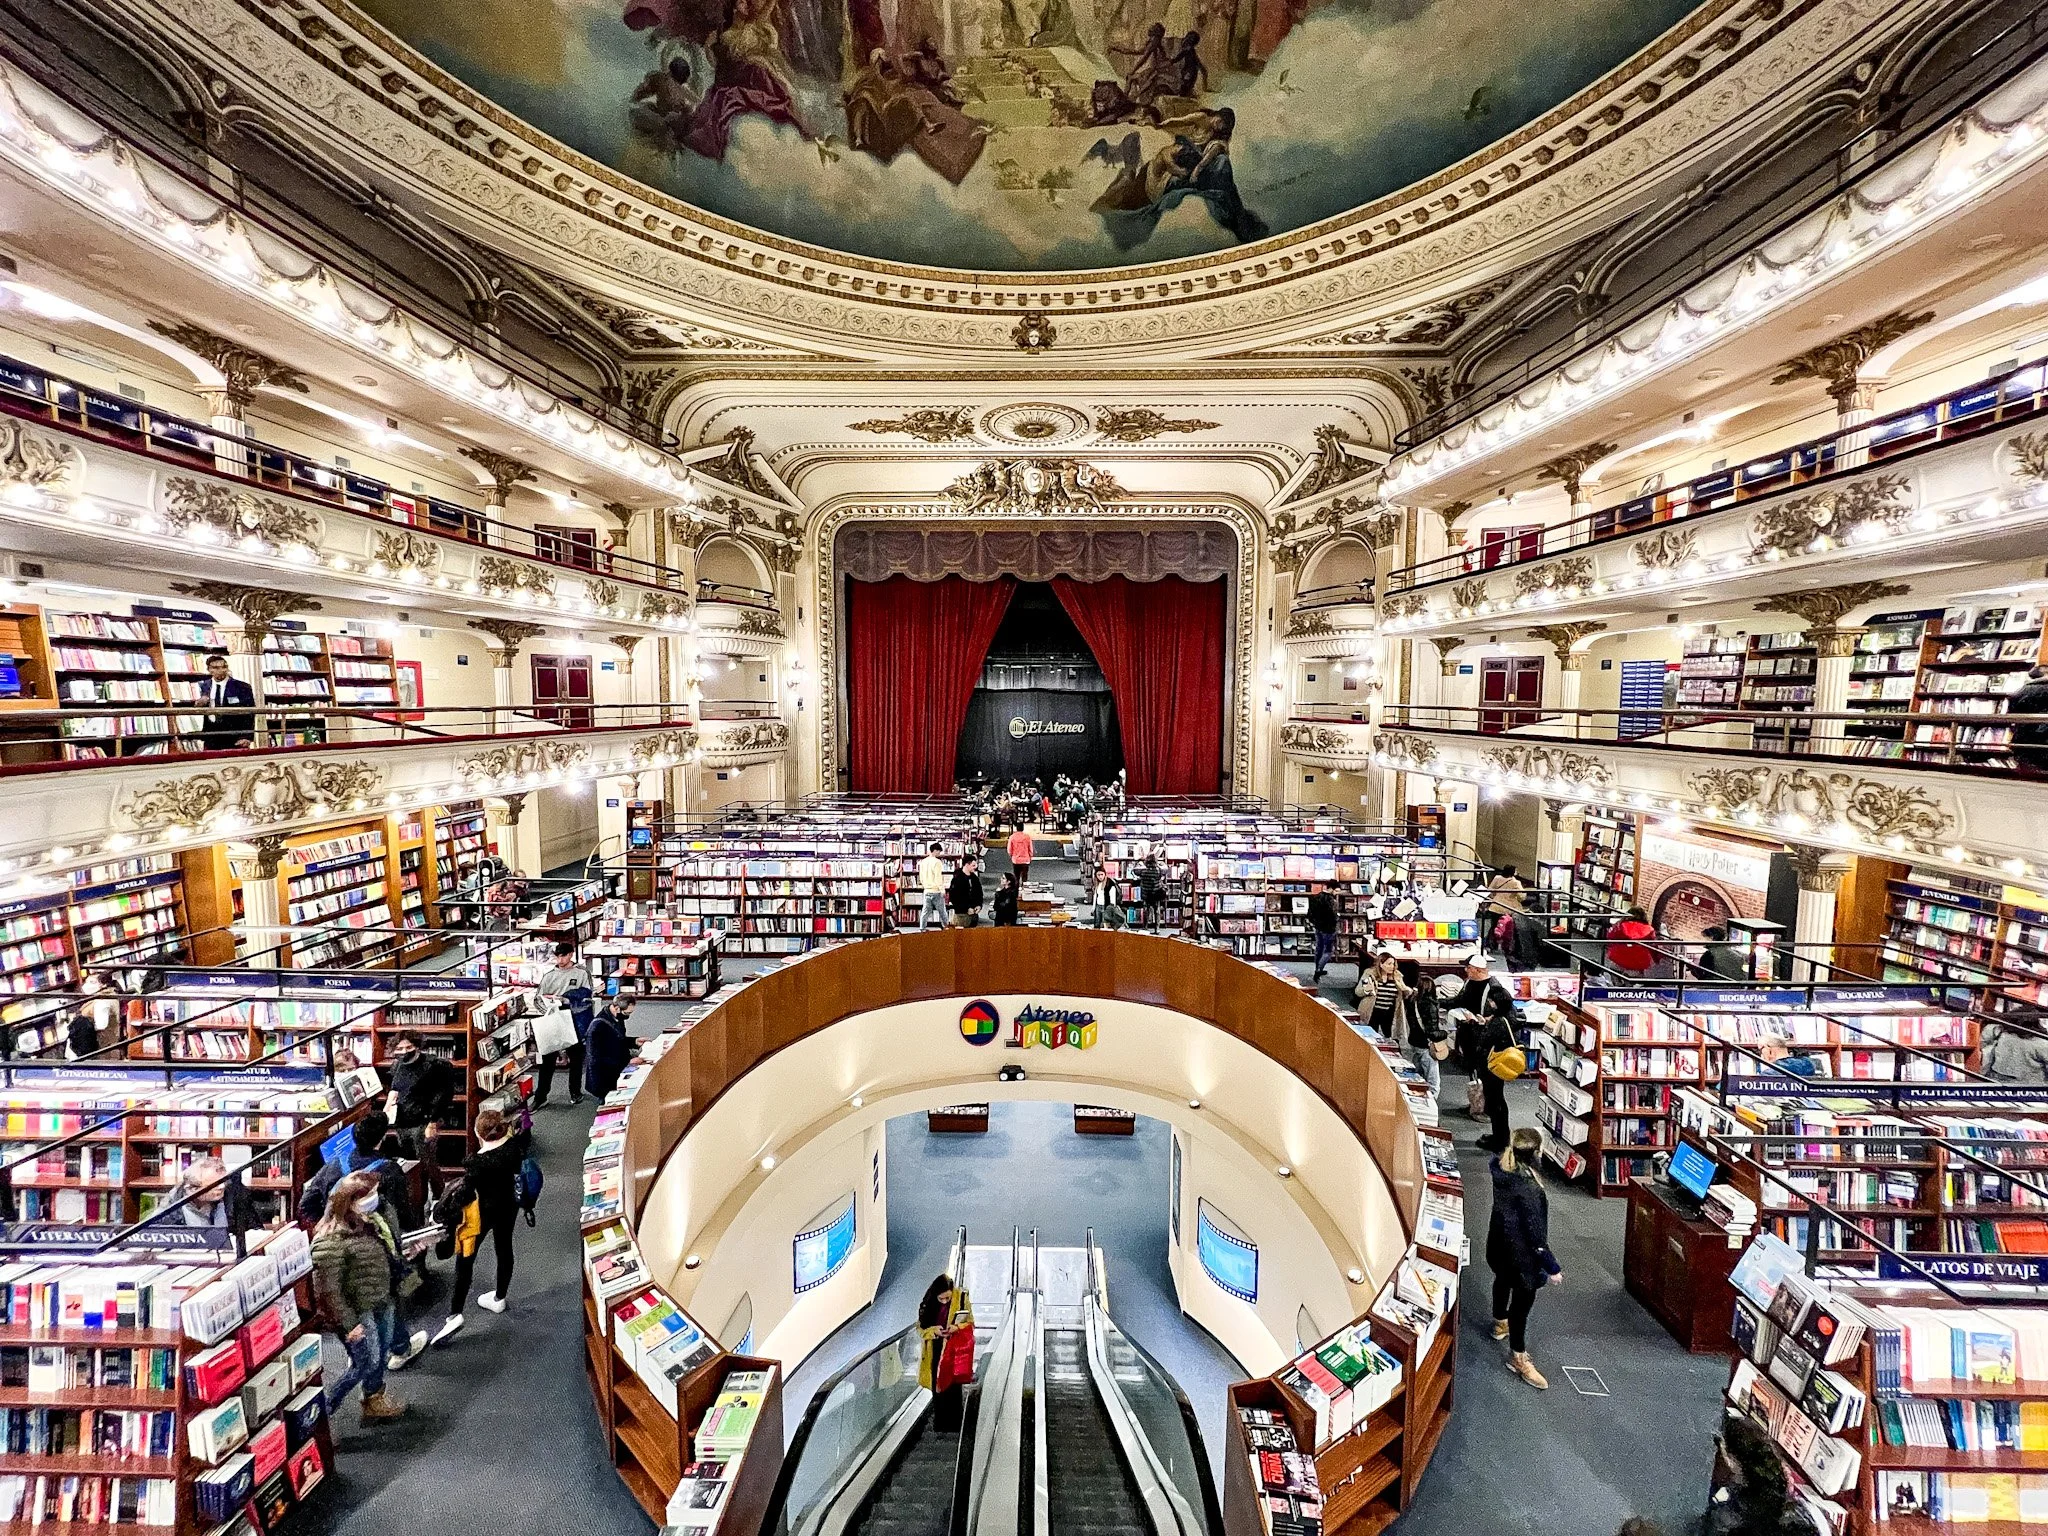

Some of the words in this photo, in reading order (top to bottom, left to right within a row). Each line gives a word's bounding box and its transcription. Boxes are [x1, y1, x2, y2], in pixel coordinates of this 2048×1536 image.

[1028, 721, 1043, 733] El
[1043, 721, 1085, 733] Ateneo
[115, 878, 148, 891] NOVELAS
[1921, 889, 1960, 903] JUVENILES
[1019, 1003, 1093, 1024] Ateneo
[1015, 1024, 1097, 1045] Junior
[1973, 1263, 1994, 1275] DE
[1997, 1263, 2040, 1280] VIAJE
[1268, 1453, 1285, 1484] CHINA
